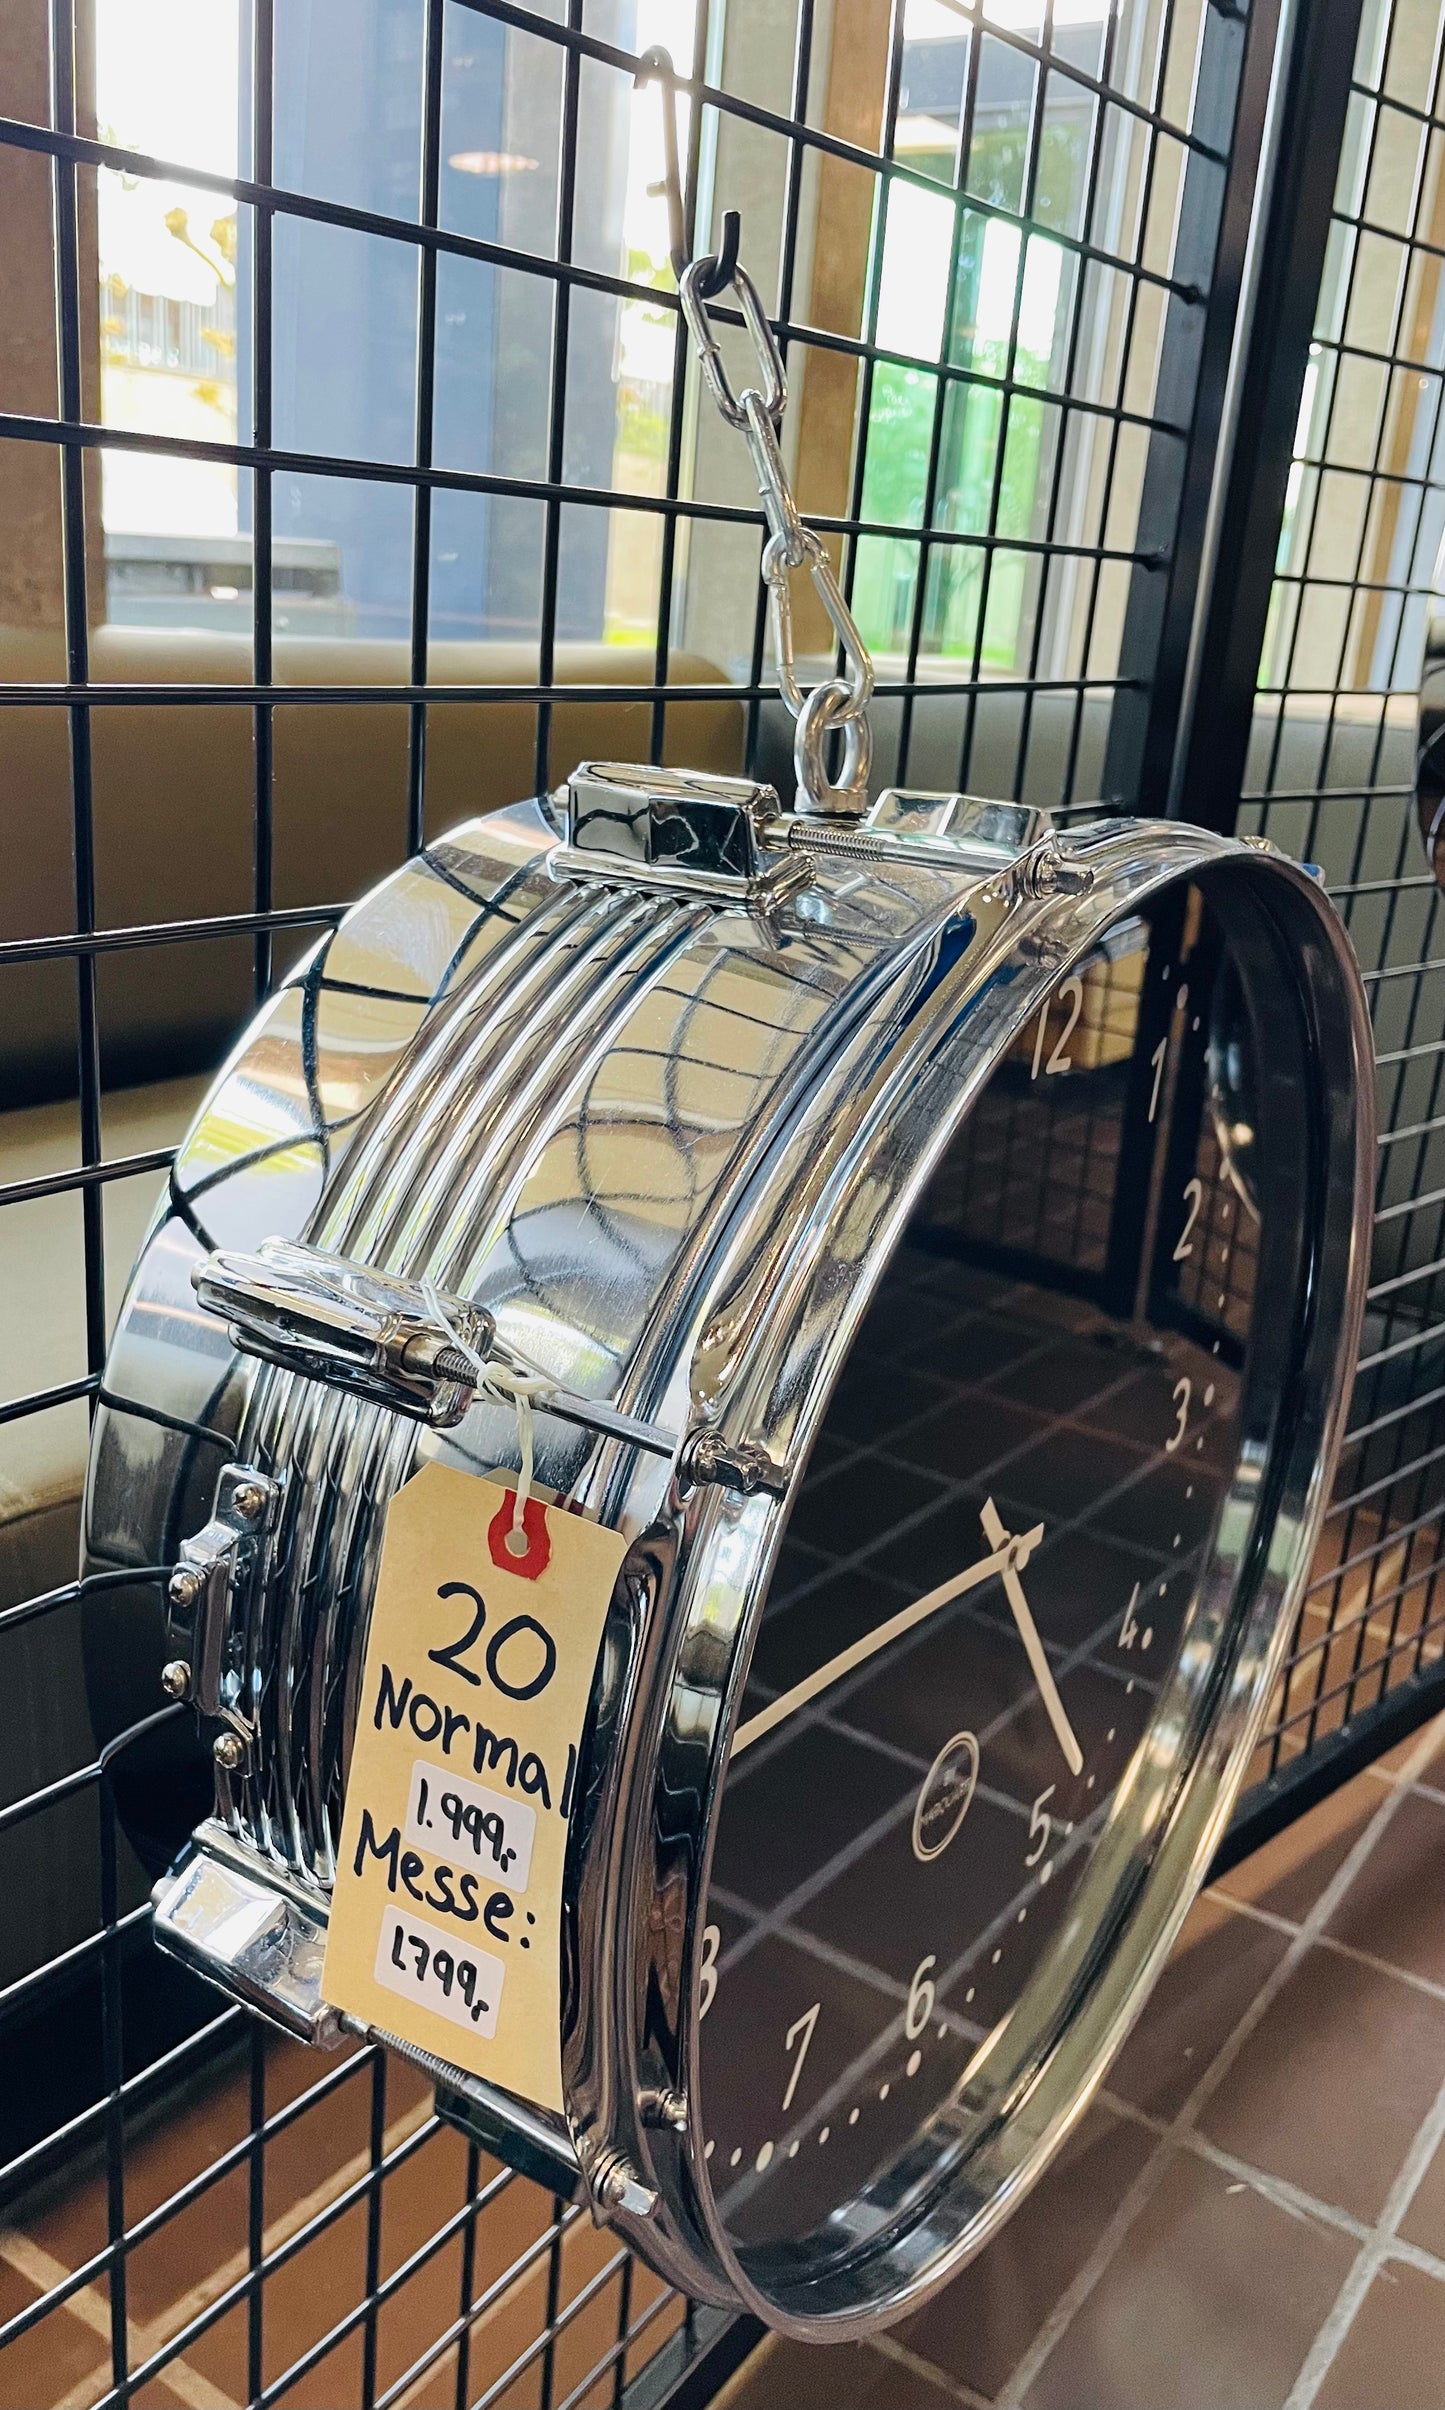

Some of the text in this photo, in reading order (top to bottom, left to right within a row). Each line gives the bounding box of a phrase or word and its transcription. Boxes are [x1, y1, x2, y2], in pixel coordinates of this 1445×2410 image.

[1030, 976, 1083, 1081] 12
[1148, 1036, 1168, 1123] 1
[1173, 1177, 1202, 1262] 2
[1165, 1377, 1192, 1453] 3
[428, 1581, 557, 1701] 20
[1118, 1581, 1140, 1650] 4
[372, 1663, 578, 1819] Normal
[1026, 1783, 1056, 1867] 5
[353, 1808, 536, 1949] Messe:
[905, 1954, 937, 2041] 6
